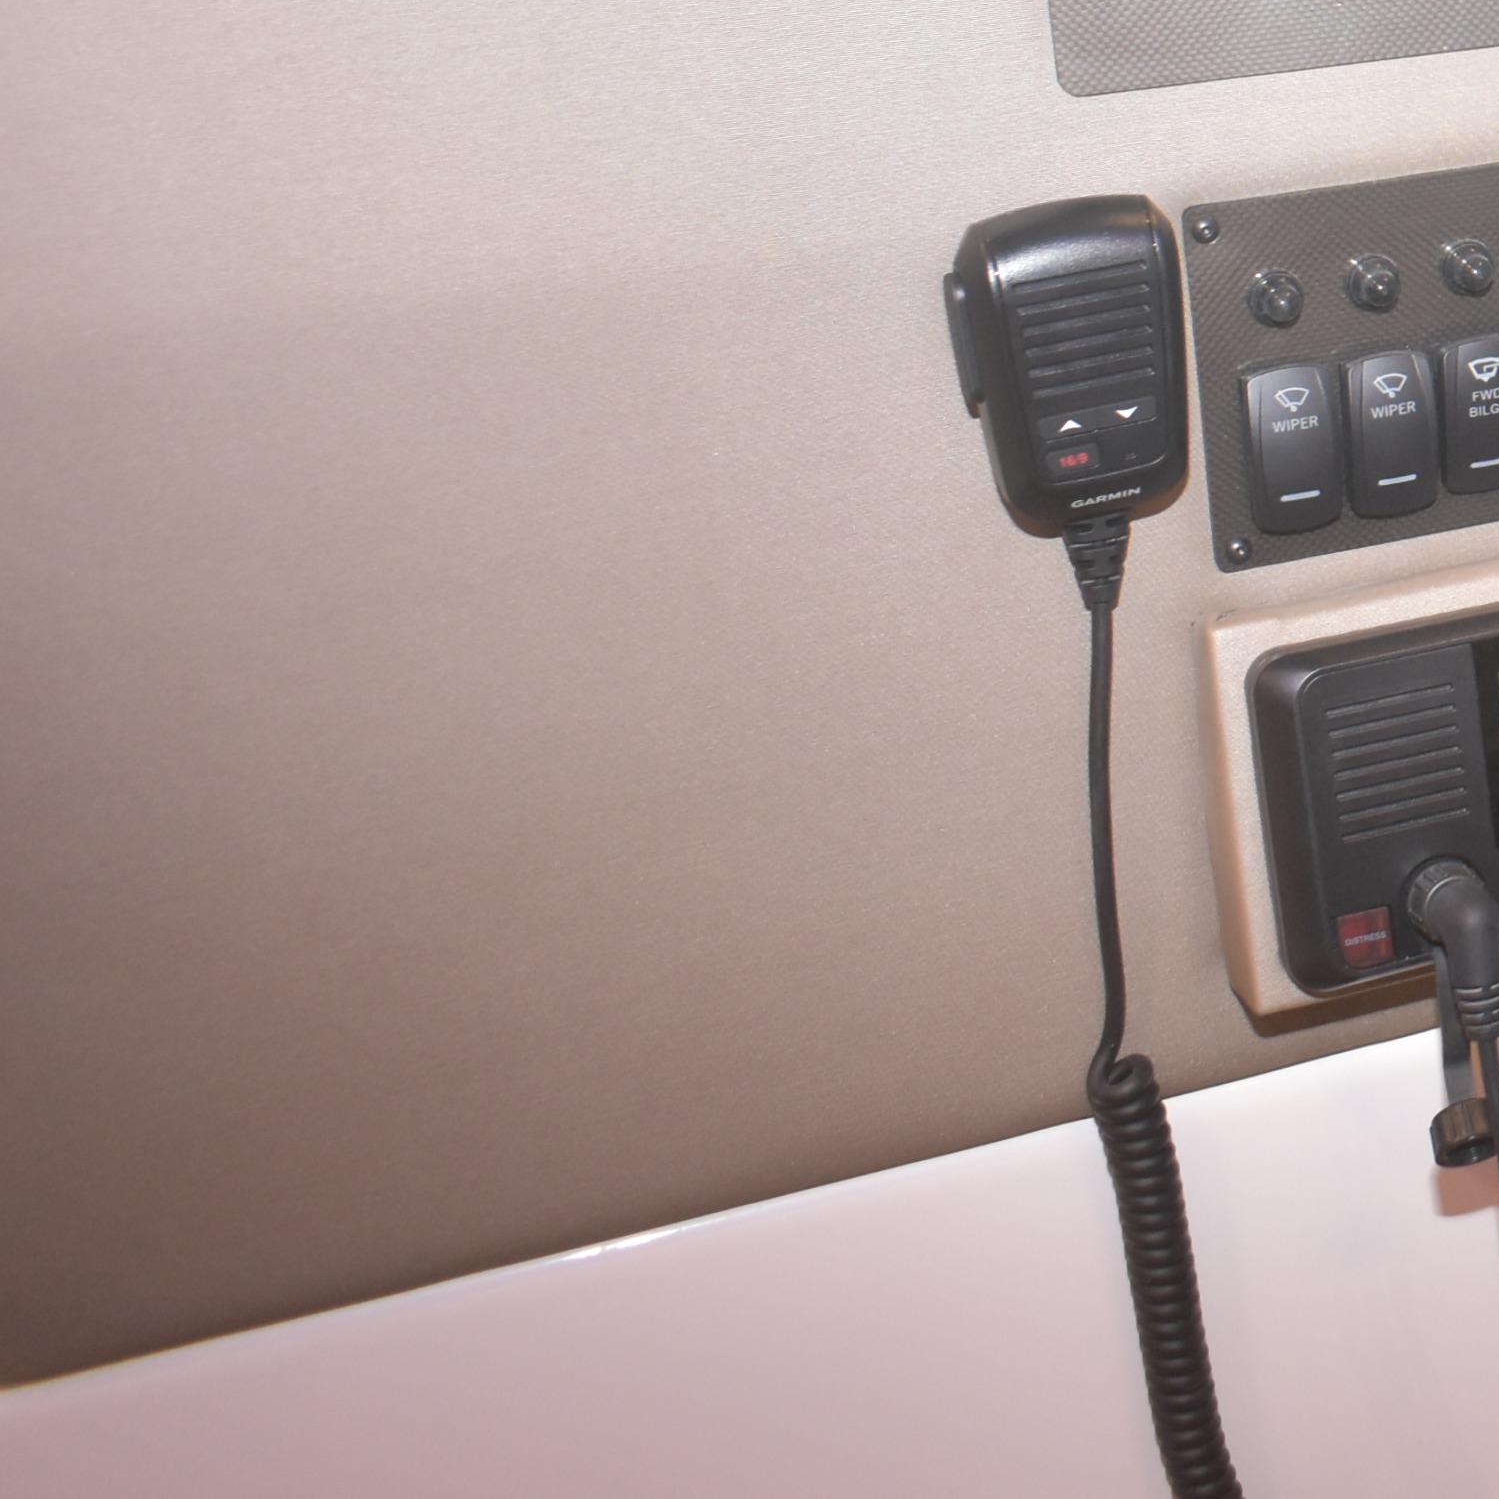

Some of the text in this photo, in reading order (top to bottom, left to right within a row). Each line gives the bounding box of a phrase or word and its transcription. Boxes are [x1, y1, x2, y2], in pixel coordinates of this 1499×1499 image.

[1371, 401, 1417, 419] WIPER
[1272, 415, 1319, 434] WIPER
[1070, 487, 1141, 508] GARMIN
[1344, 930, 1387, 947] DISTRESS
